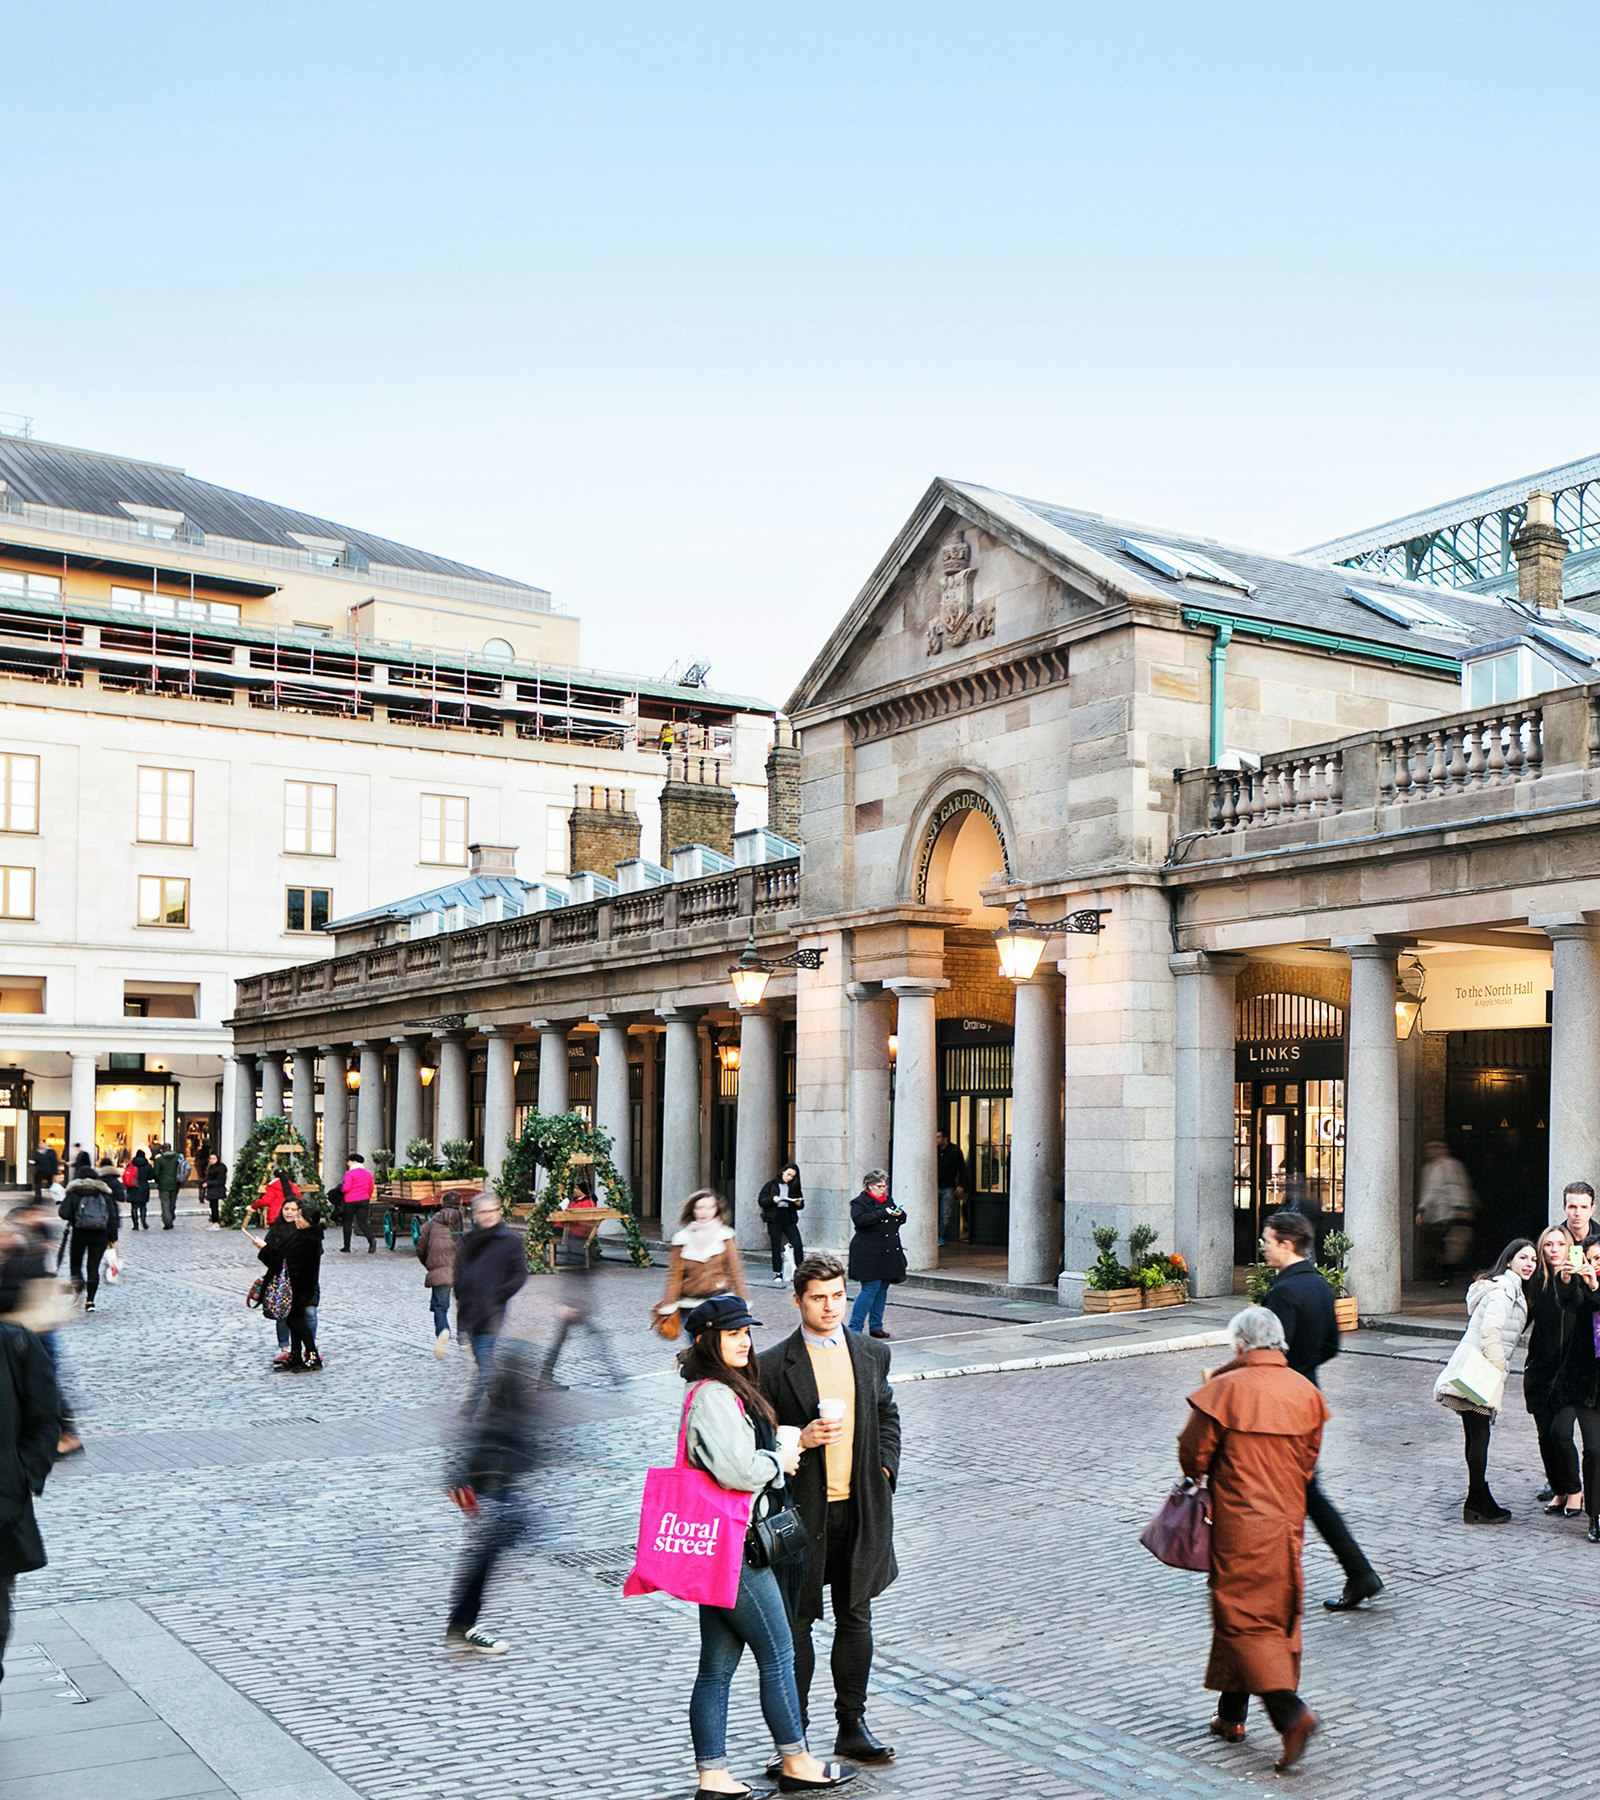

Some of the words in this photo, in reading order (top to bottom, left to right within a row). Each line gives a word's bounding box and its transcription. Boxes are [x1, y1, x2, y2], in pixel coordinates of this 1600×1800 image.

[941, 793, 985, 822] GARDEN
[1455, 987, 1467, 999] To
[1468, 985, 1483, 998] the
[1484, 982, 1512, 997] North
[1513, 980, 1533, 995] Hall
[568, 1046, 585, 1057] HANEL
[1250, 1046, 1300, 1061] LINKS
[658, 1512, 720, 1539] floral
[653, 1536, 717, 1556] street
